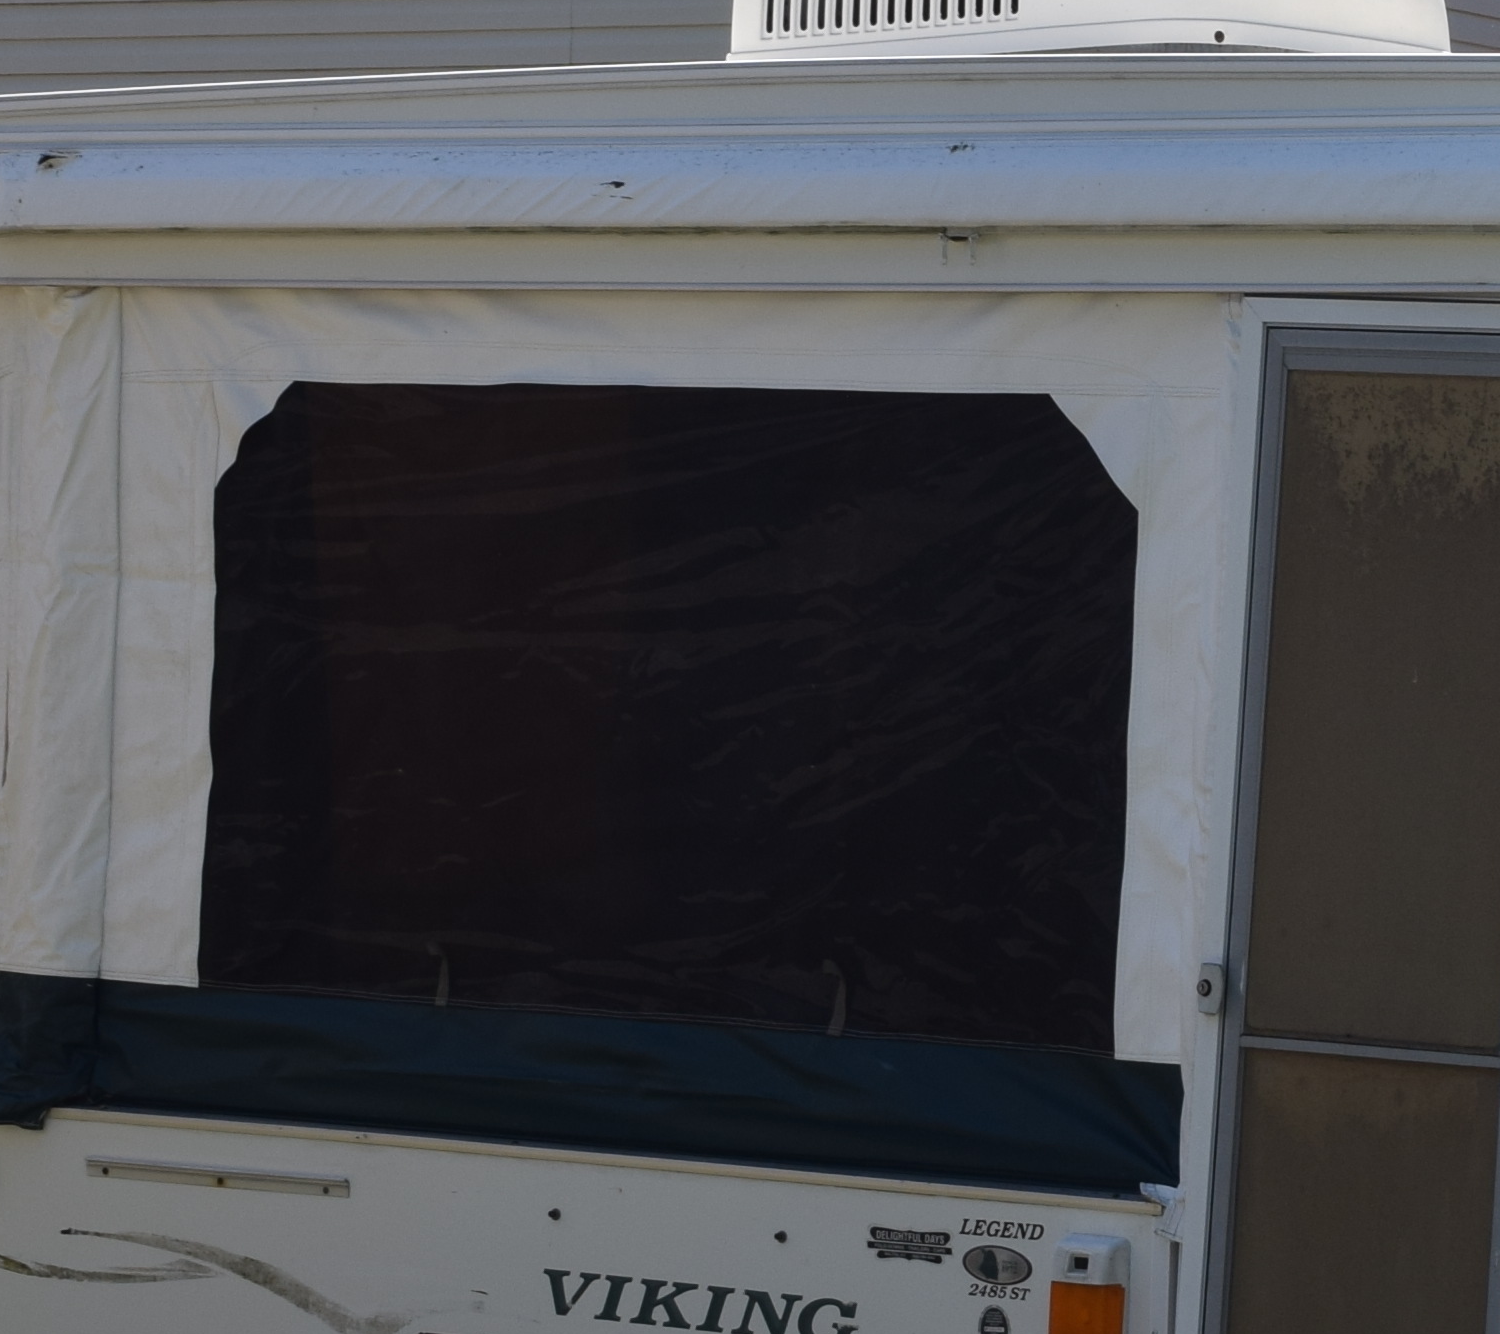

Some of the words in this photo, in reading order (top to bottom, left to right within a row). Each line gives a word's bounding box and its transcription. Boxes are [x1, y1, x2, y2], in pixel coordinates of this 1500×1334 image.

[875, 1230, 922, 1243] DELIGHTFUL
[924, 1234, 945, 1245] DAYS
[959, 1218, 1044, 1241] LEGEND
[968, 1283, 1008, 1299] 2485
[1010, 1287, 1031, 1301] ST
